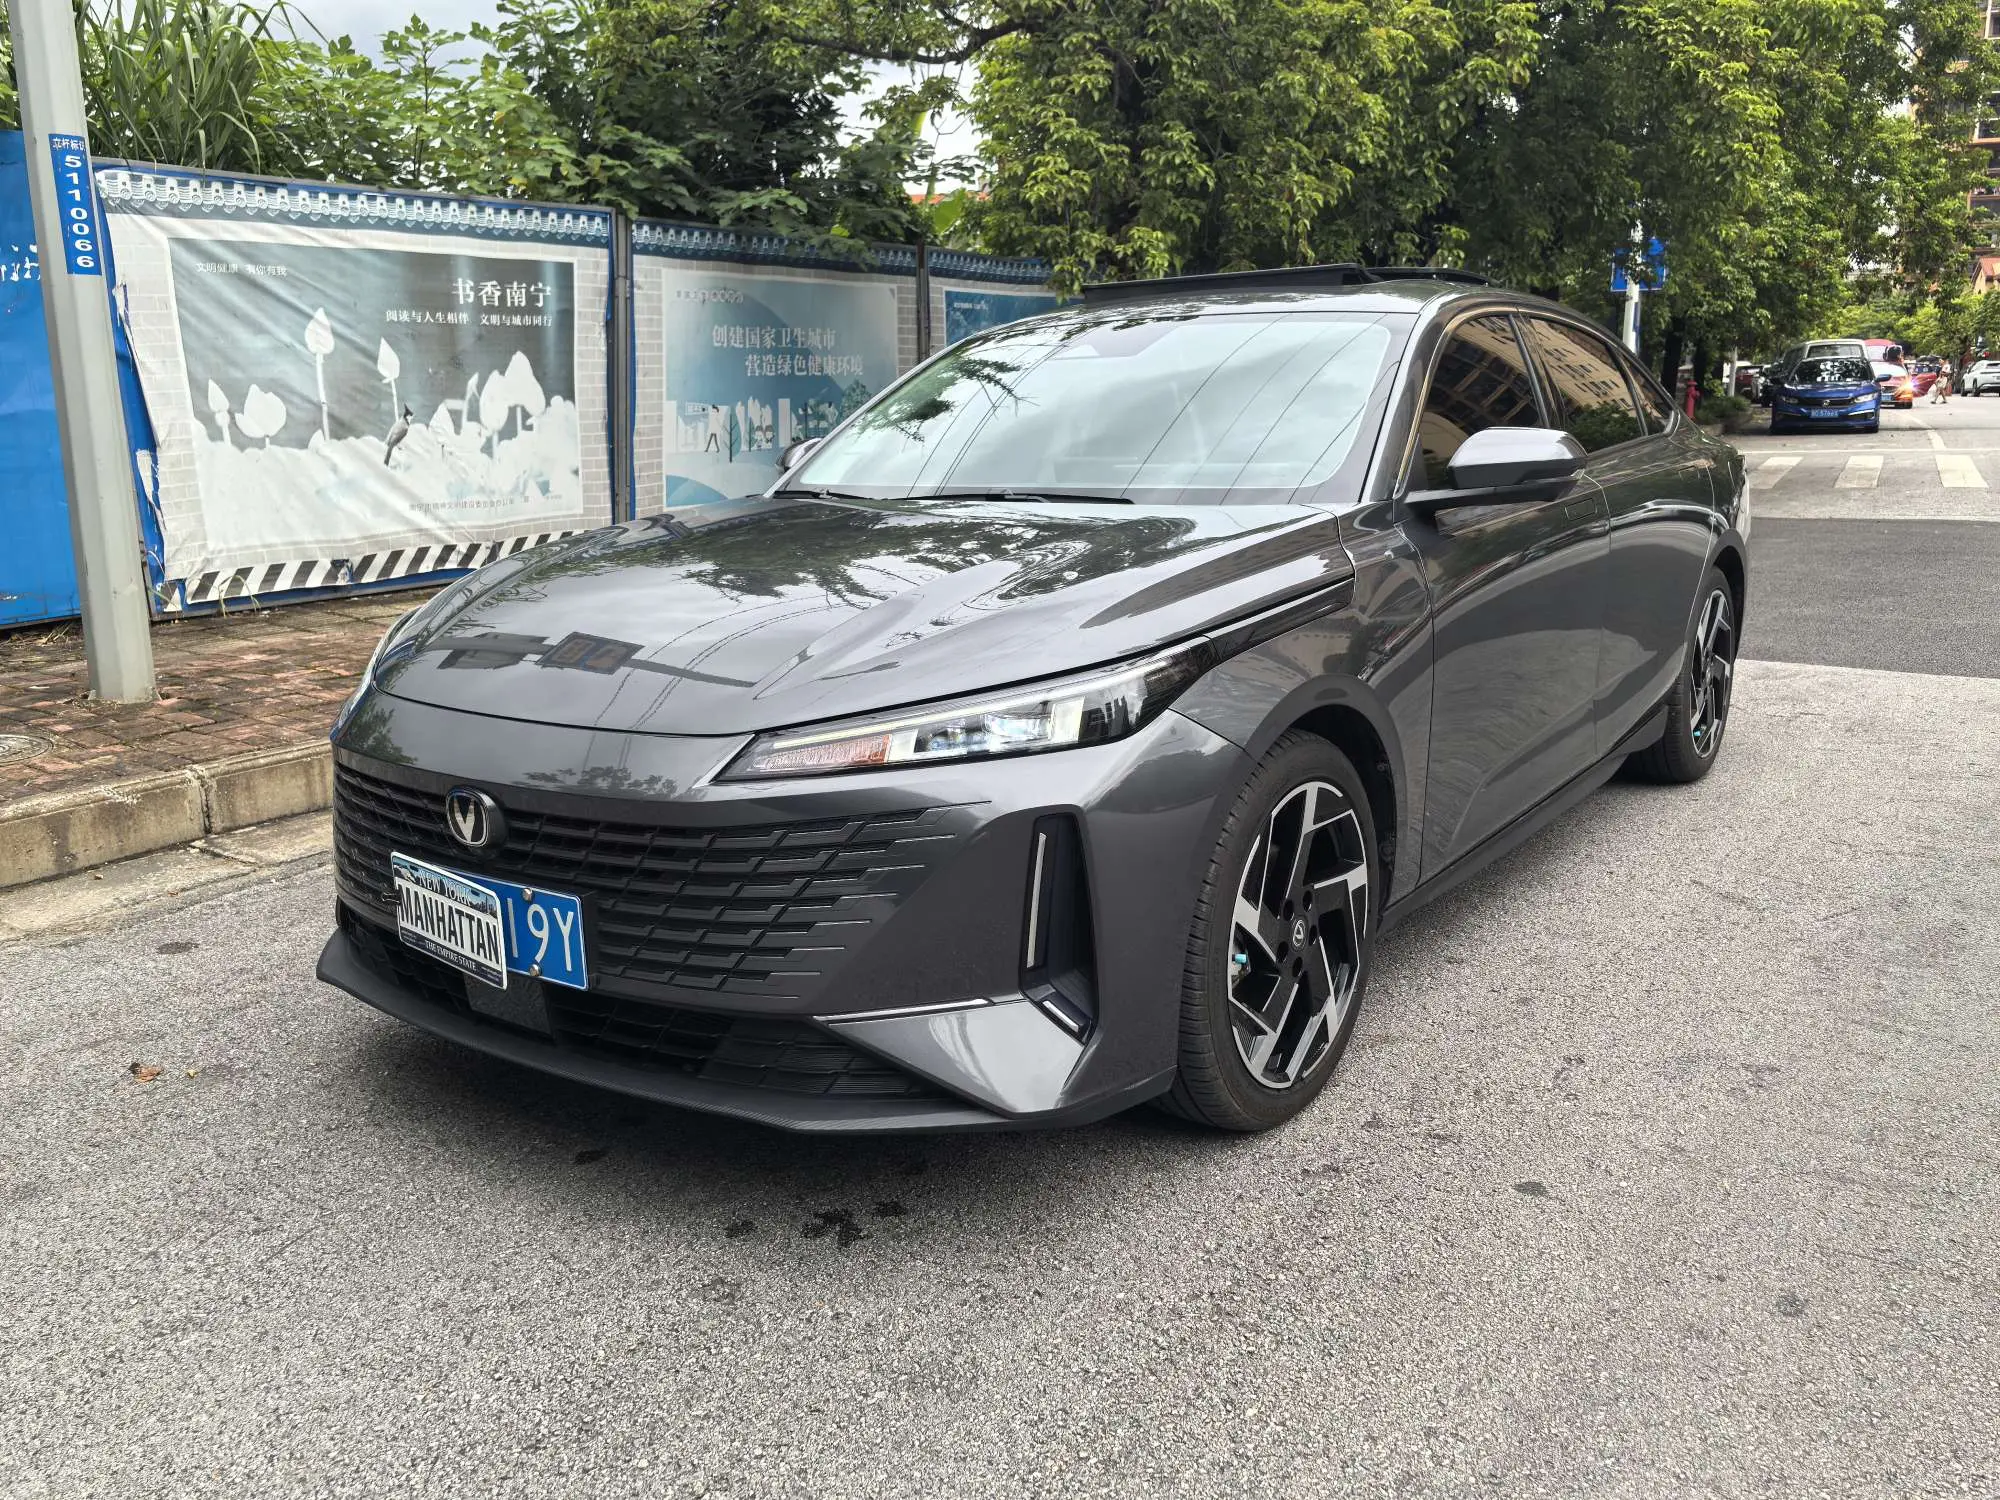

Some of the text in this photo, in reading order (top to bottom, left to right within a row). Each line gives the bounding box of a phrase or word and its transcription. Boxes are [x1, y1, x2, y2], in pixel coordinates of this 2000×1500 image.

[64, 155, 95, 268] 5110066
[452, 277, 551, 308] 书香南宁
[386, 310, 553, 327] 阅读与人生相伴 文明与城市同行
[712, 325, 837, 350] 创建国家卫生城市
[745, 354, 864, 377] 营造绿色健康环境
[419, 870, 472, 906] NEW YORK
[398, 884, 500, 965] MANHATTAN
[424, 939, 477, 972] THE EMPIRE STATE
